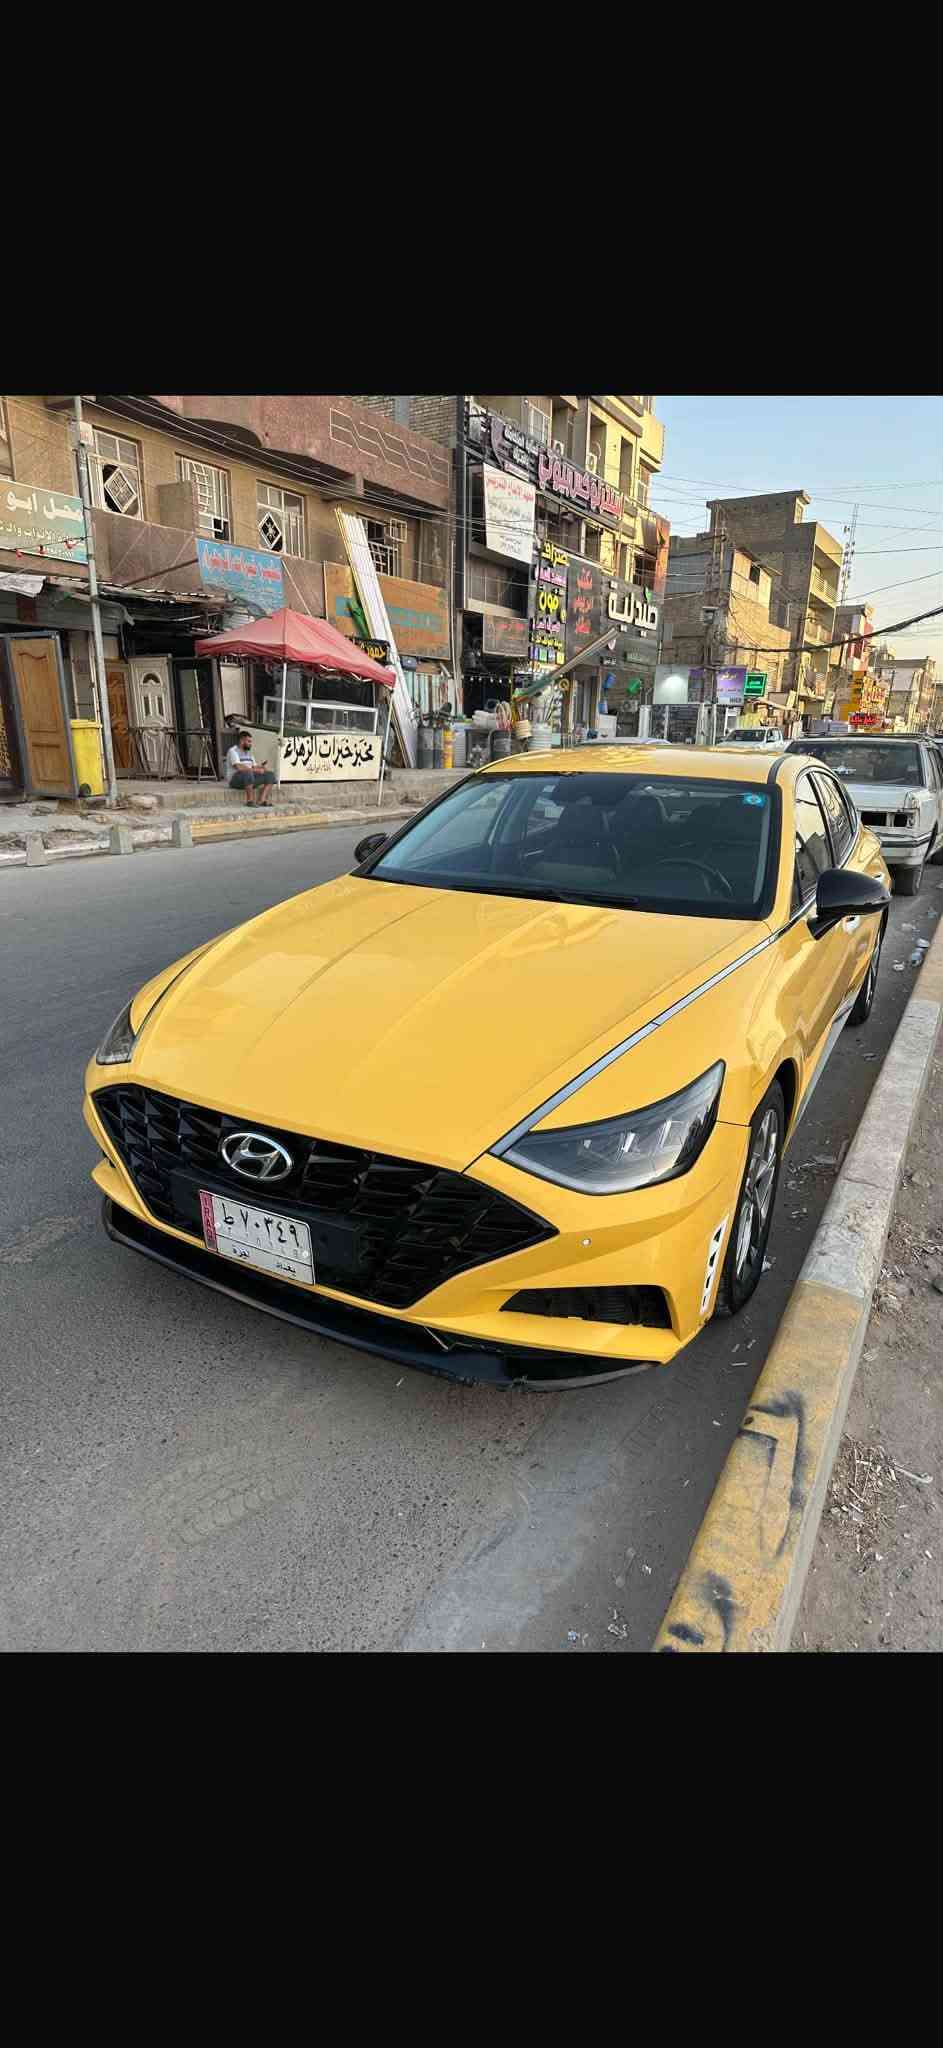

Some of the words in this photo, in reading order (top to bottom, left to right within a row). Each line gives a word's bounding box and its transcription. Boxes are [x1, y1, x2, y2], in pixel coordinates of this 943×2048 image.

[607, 580, 658, 638] صيدلية
[283, 736, 318, 767] الزهراء
[318, 736, 354, 769] خيرات
[351, 738, 375, 768] مخبز
